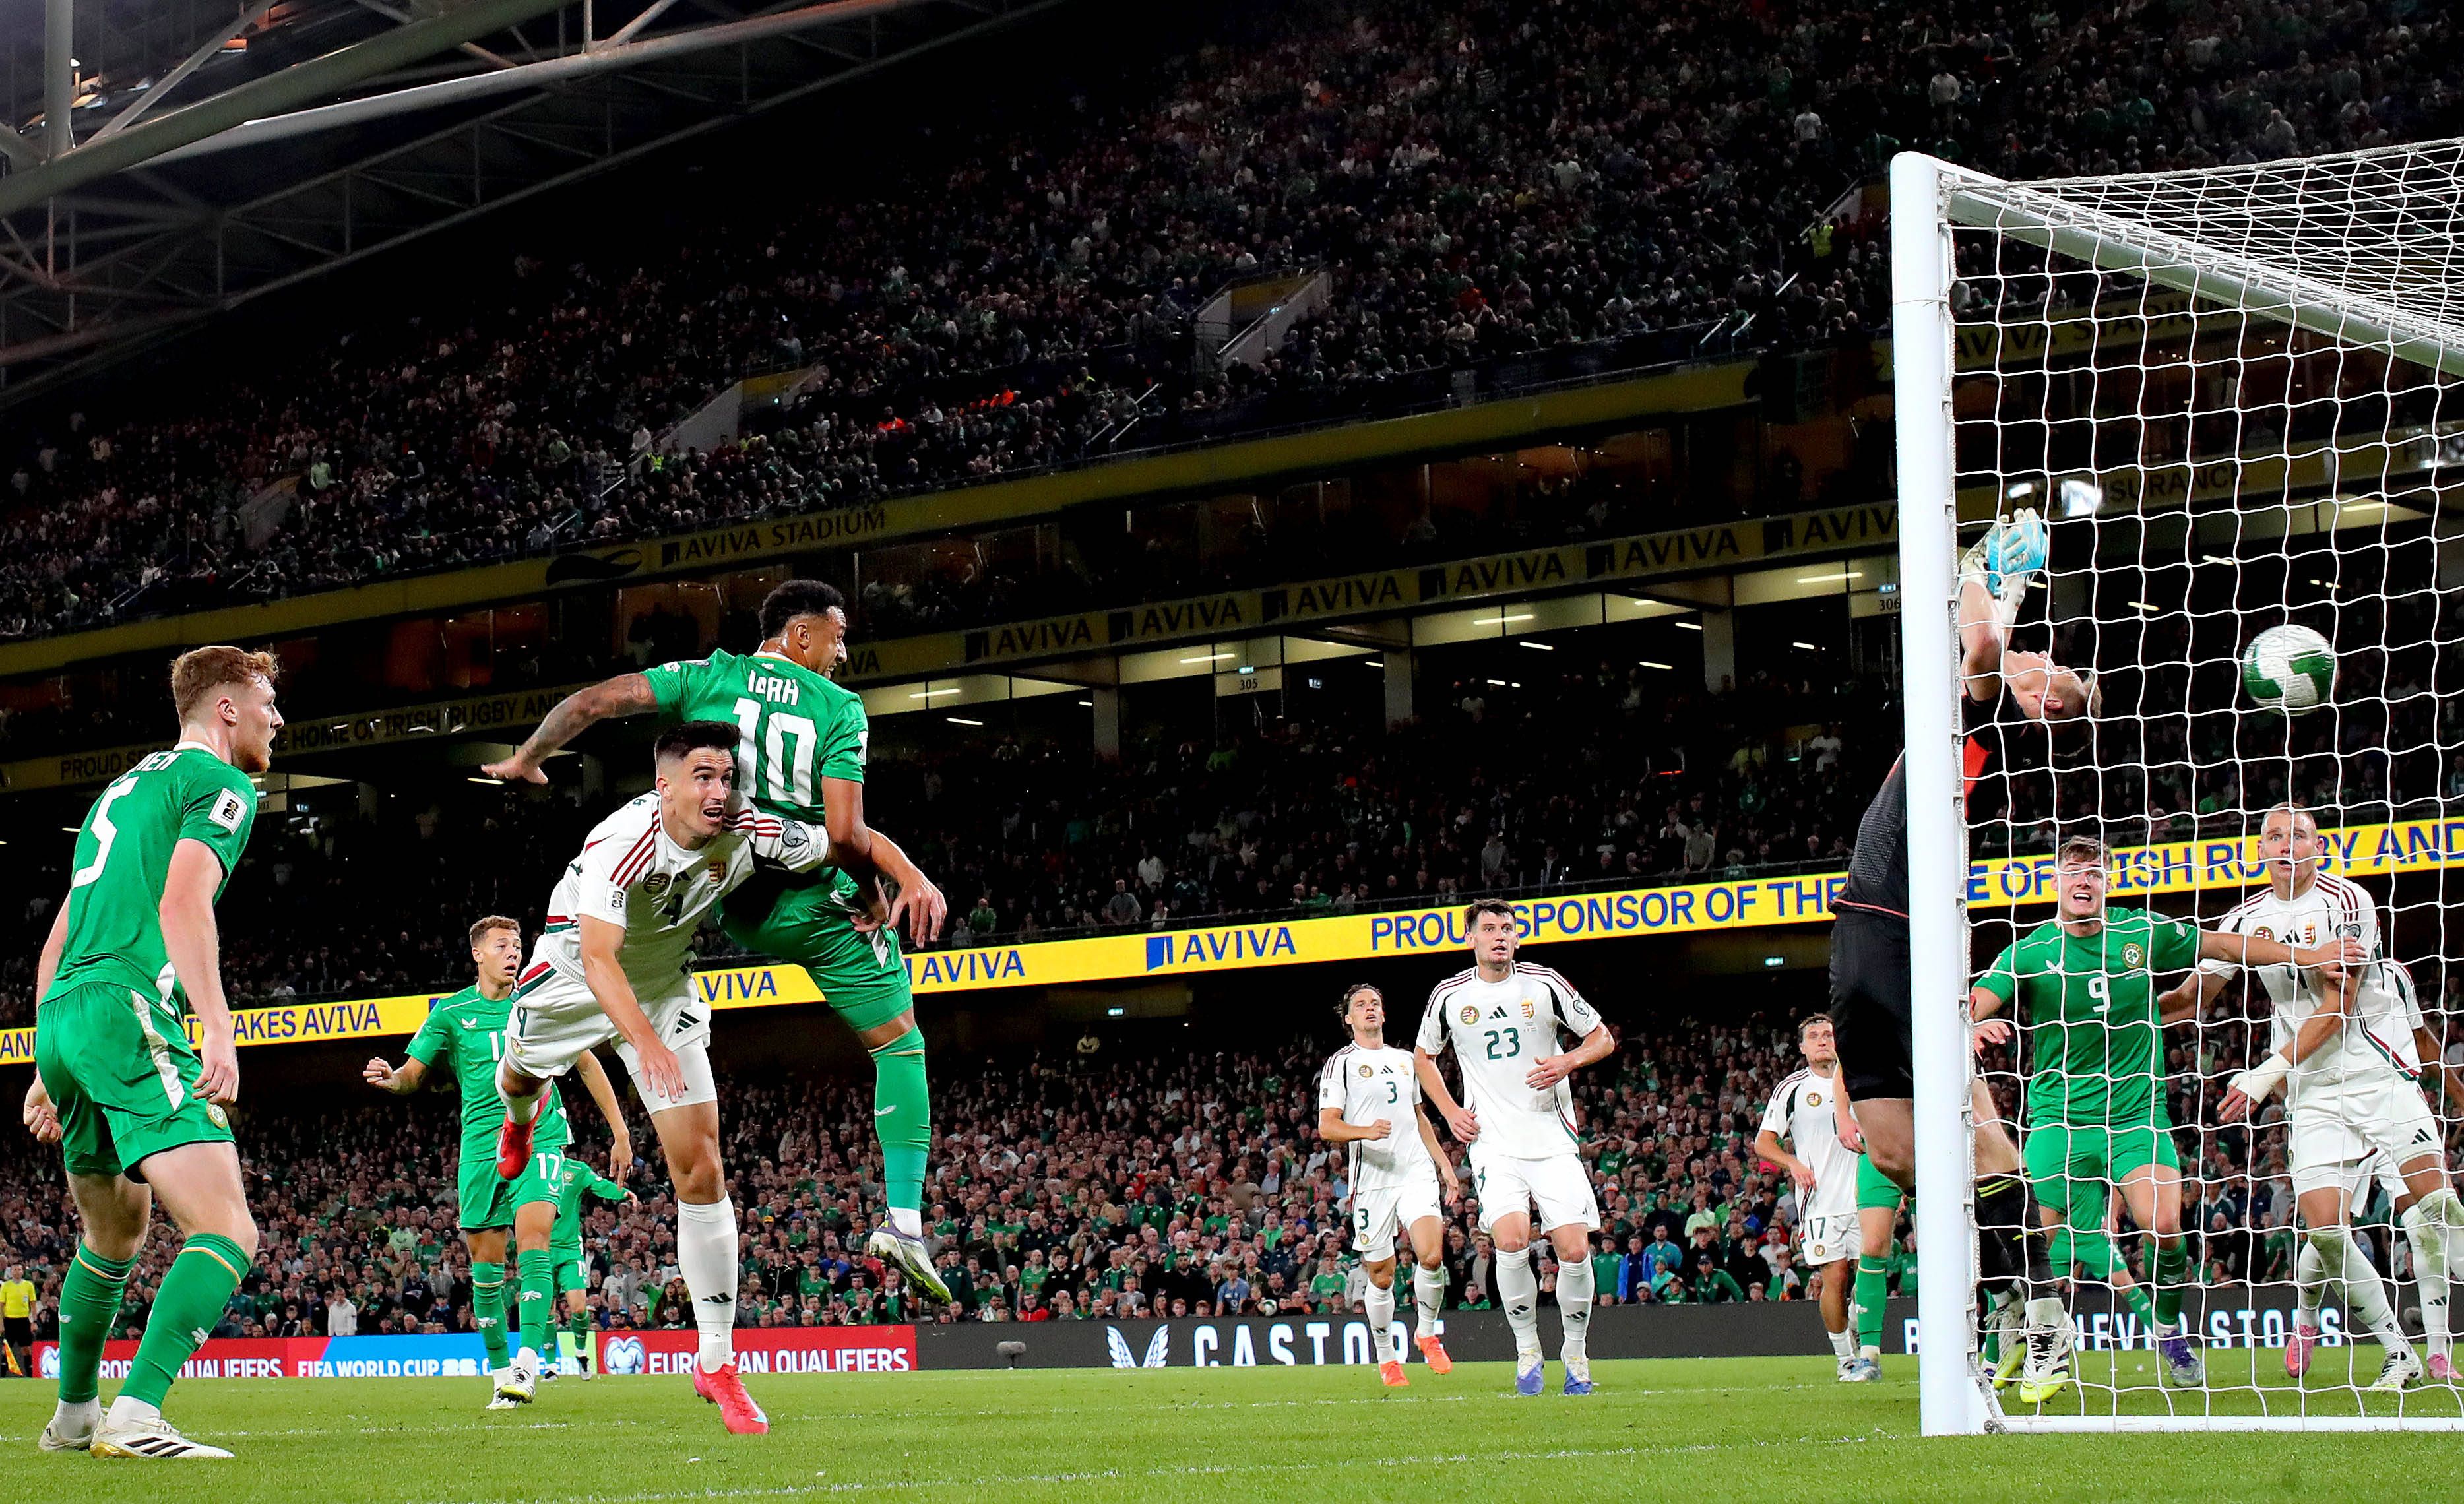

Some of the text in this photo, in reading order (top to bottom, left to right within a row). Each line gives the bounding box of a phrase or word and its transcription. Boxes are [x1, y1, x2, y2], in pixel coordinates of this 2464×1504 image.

[1957, 321, 2058, 358] AVVA
[685, 509, 885, 560] AVIVA STADIUM
[1803, 505, 1897, 546] AVIV
[1624, 528, 1740, 569] AVIVA
[1455, 553, 1565, 593] AVIVA
[1296, 576, 1401, 614] AVIVA
[1878, 598, 1901, 612] 306
[1141, 598, 1242, 635] AVIVA
[997, 618, 1092, 654] AVIVA
[839, 650, 881, 677] IVA
[1239, 678, 1258, 691] 305
[292, 724, 349, 751] HOME
[385, 709, 441, 736] IRISH
[449, 697, 517, 731] RUGBY
[61, 755, 122, 781] PROUD
[732, 697, 817, 807] 10
[2001, 860, 2054, 898] OF
[2112, 848, 2193, 889] ISH
[2207, 831, 2361, 881] RUBY
[2374, 822, 2464, 867] AND
[1372, 911, 1467, 951] PROU
[1514, 891, 1695, 939] SPONSOR
[1705, 885, 1758, 921] OF
[1182, 927, 1296, 963] AVIVA
[702, 970, 778, 1001] VIVA
[920, 950, 1025, 985] AVIVA
[2088, 976, 2111, 1013] 9
[1, 1003, 382, 1057] AN I AKES AVIVA
[1484, 1027, 1521, 1060] 23
[1386, 1081, 1397, 1104] 3
[536, 1152, 561, 1181] 17
[1358, 1208, 1369, 1230] 3
[1809, 1216, 1826, 1240] 17
[298, 1360, 334, 1378] FIFA
[336, 1359, 401, 1377] WORLD
[403, 1359, 439, 1377] CUP
[649, 1348, 910, 1374] EURAN QUALIFIERS
